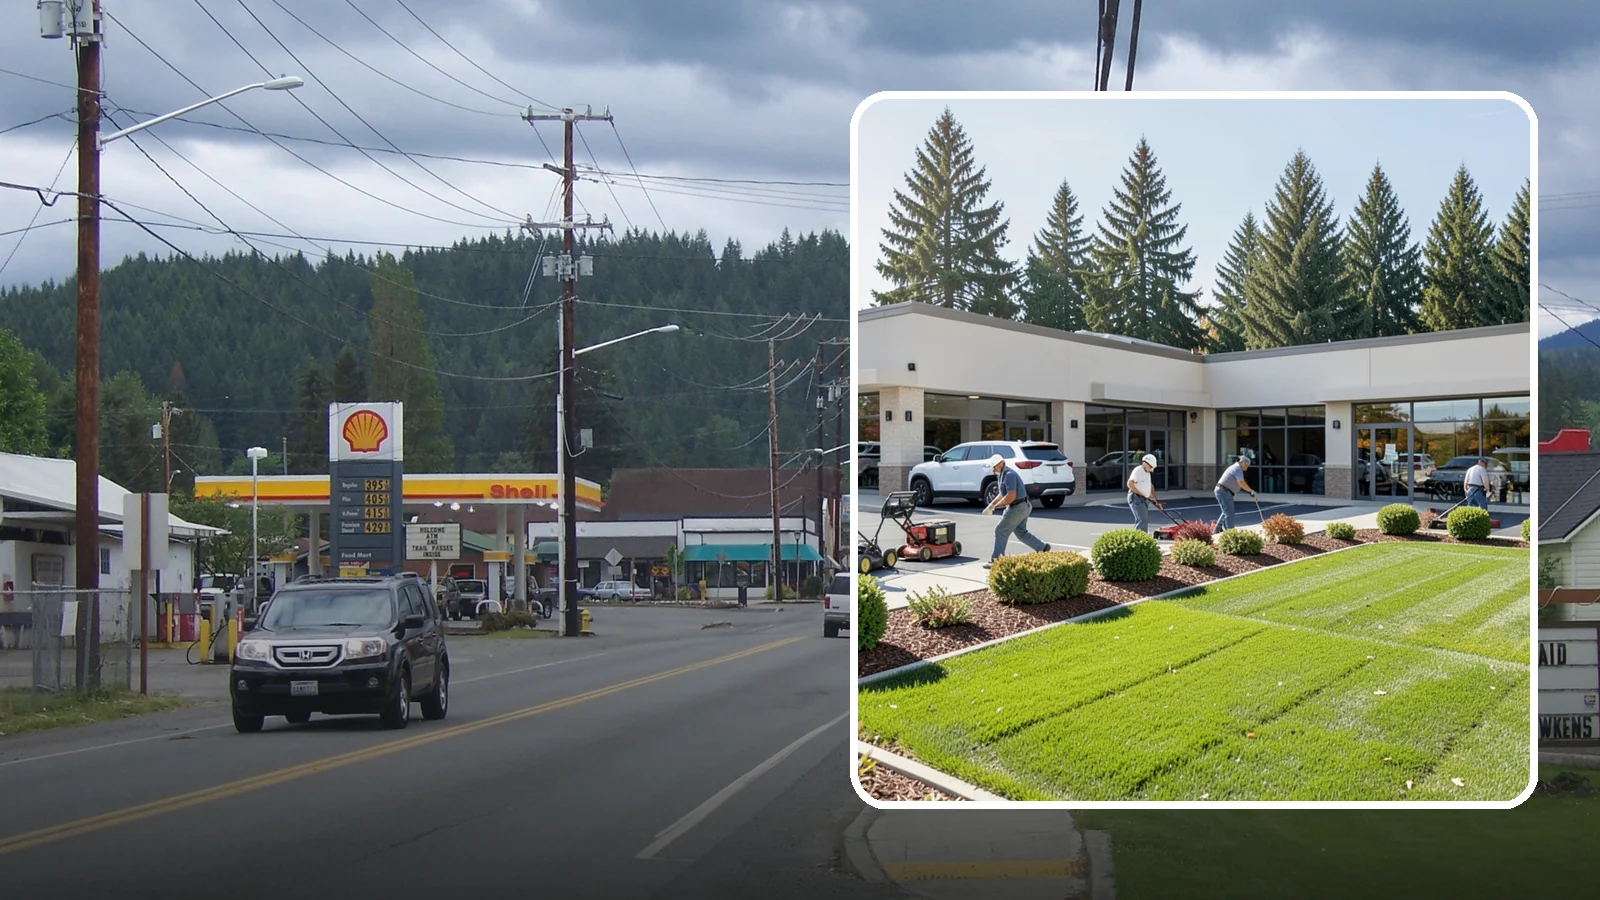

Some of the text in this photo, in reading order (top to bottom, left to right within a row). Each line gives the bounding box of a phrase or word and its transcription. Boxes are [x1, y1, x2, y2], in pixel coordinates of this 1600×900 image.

[366, 480, 383, 490] 395
[490, 484, 547, 499] Shell
[366, 494, 383, 504] 405
[366, 508, 383, 518] 415
[366, 522, 383, 532] 429
[1538, 643, 1566, 665] AID
